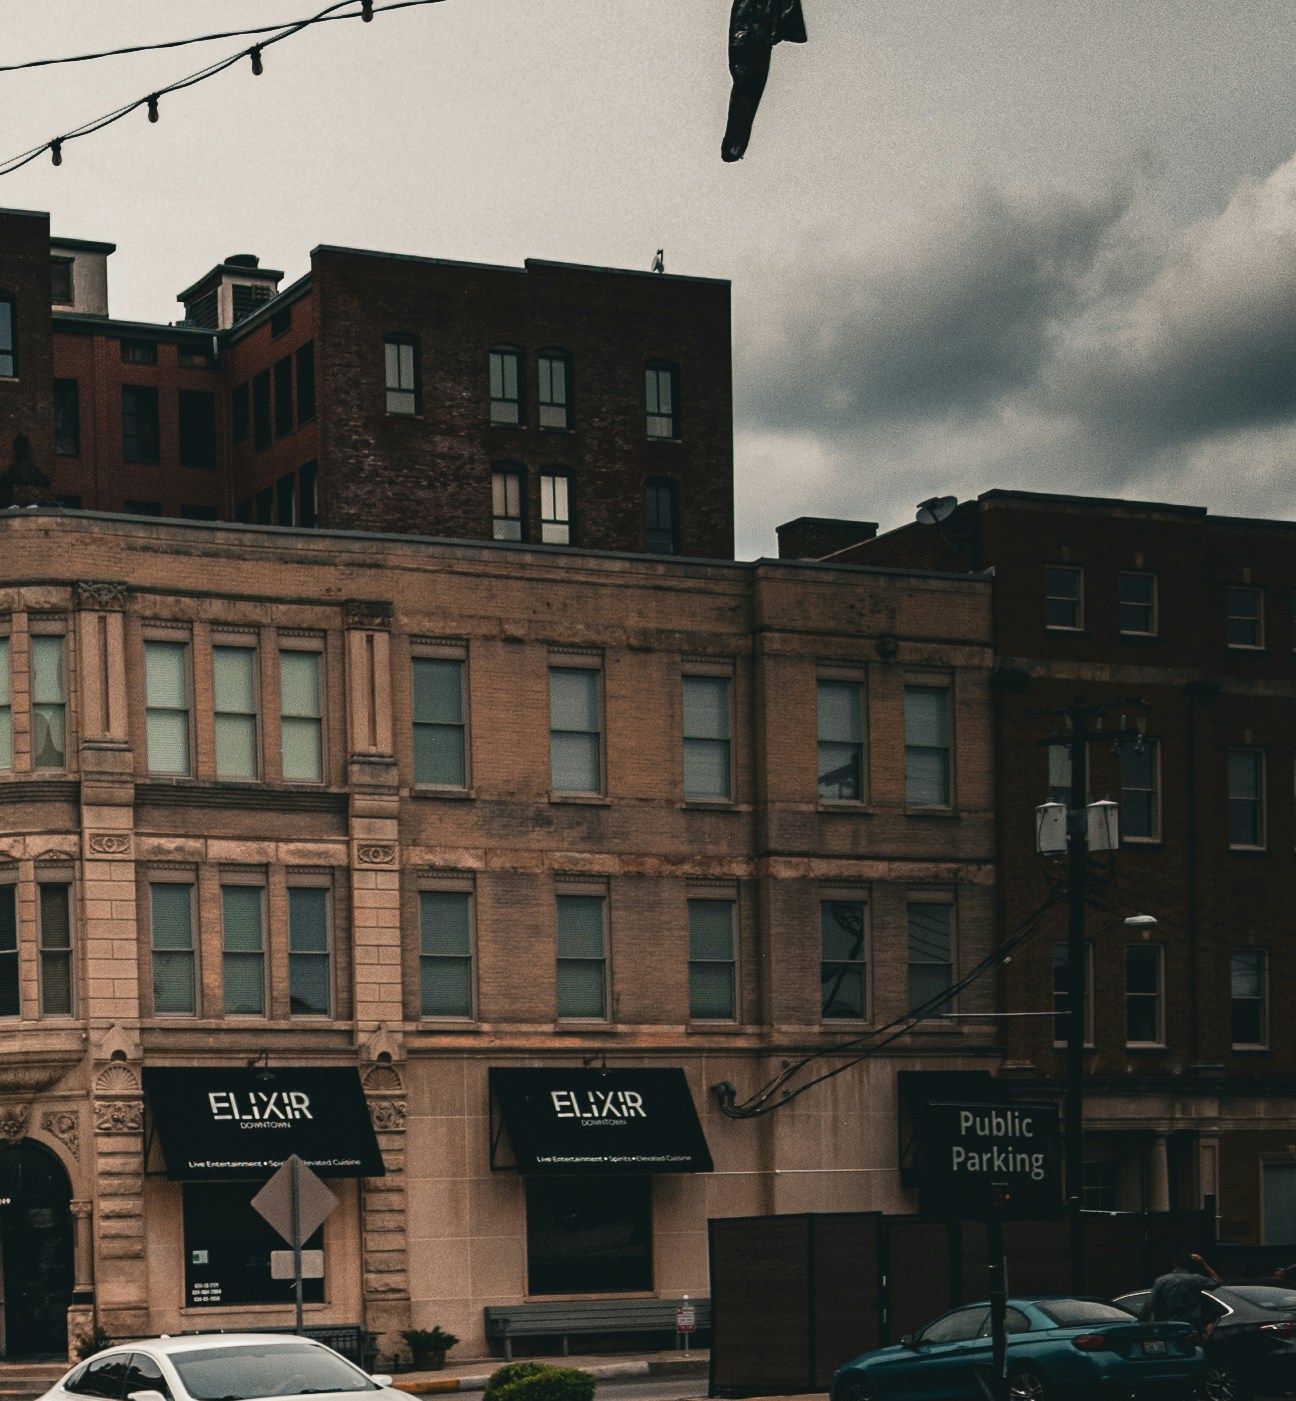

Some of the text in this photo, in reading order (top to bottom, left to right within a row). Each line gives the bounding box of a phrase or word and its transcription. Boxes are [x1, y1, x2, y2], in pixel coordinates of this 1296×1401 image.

[208, 1092, 313, 1120] ELIXIR
[550, 1090, 647, 1118] ELIXIR
[240, 1121, 292, 1129] DOWNTOWN
[960, 1110, 1034, 1138] Public
[206, 1160, 263, 1168] Entertainment
[552, 1155, 604, 1163] Entertainment
[952, 1145, 1045, 1181] Parking
